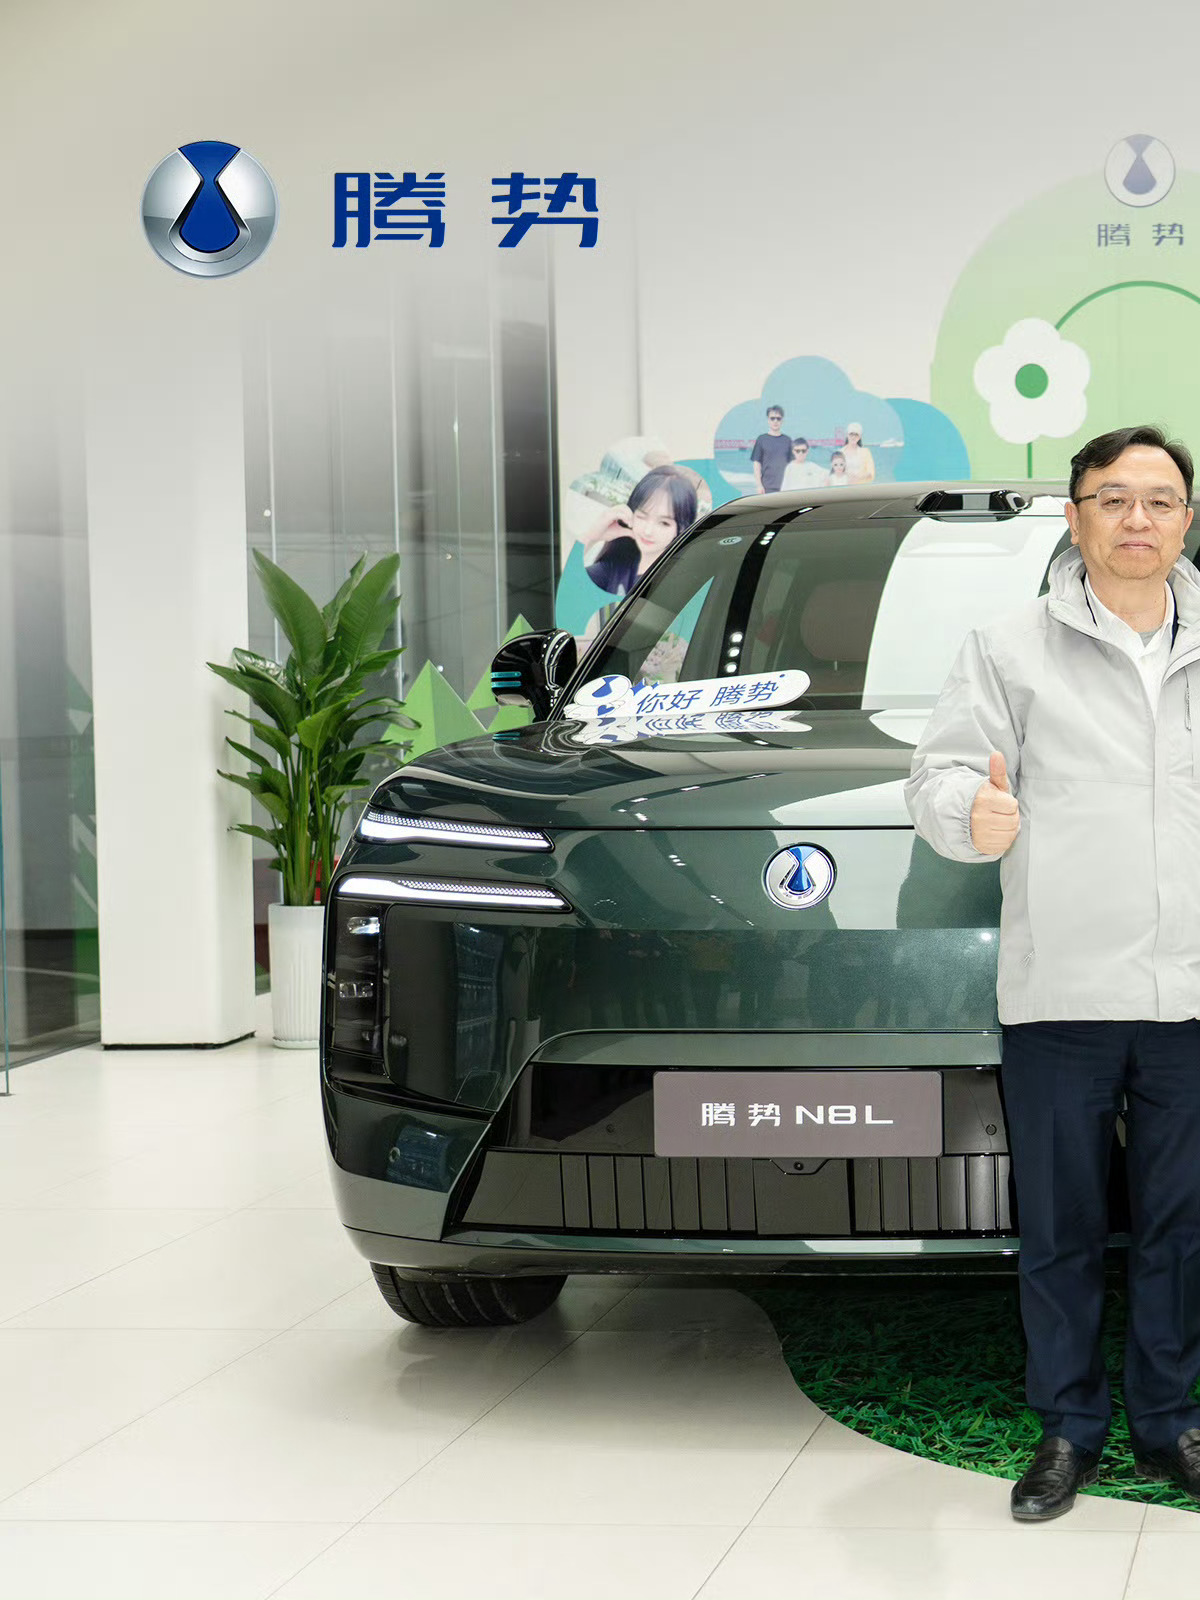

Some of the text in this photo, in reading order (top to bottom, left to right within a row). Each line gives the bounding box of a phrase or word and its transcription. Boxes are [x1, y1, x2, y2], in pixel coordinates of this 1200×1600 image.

[1097, 223, 1184, 247] 腾势
[635, 680, 779, 714] 你好 腾势
[701, 1102, 894, 1127] 腾势 N8L
